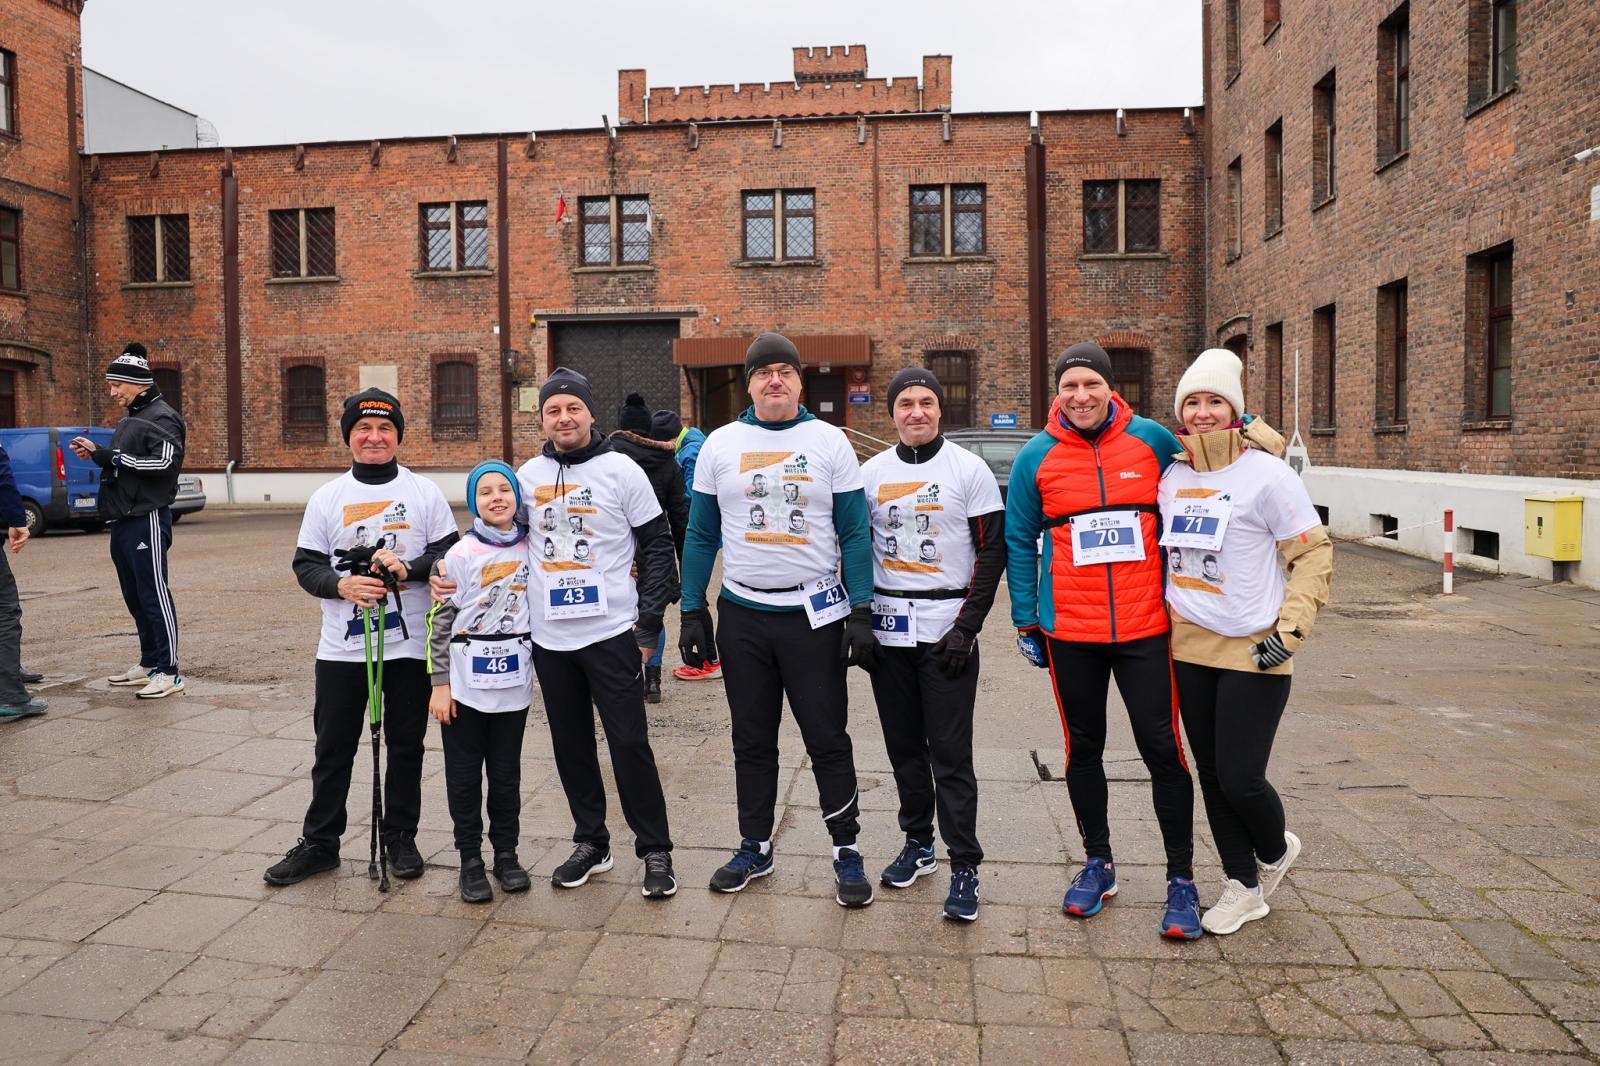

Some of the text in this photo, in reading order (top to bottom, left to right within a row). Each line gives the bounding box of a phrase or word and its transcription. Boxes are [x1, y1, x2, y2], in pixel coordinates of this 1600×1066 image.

[1184, 516, 1203, 533] 71
[1095, 529, 1119, 545] 70
[563, 588, 585, 603] 43
[825, 587, 841, 604] 42
[880, 615, 896, 631] 49
[486, 657, 508, 673] 46
